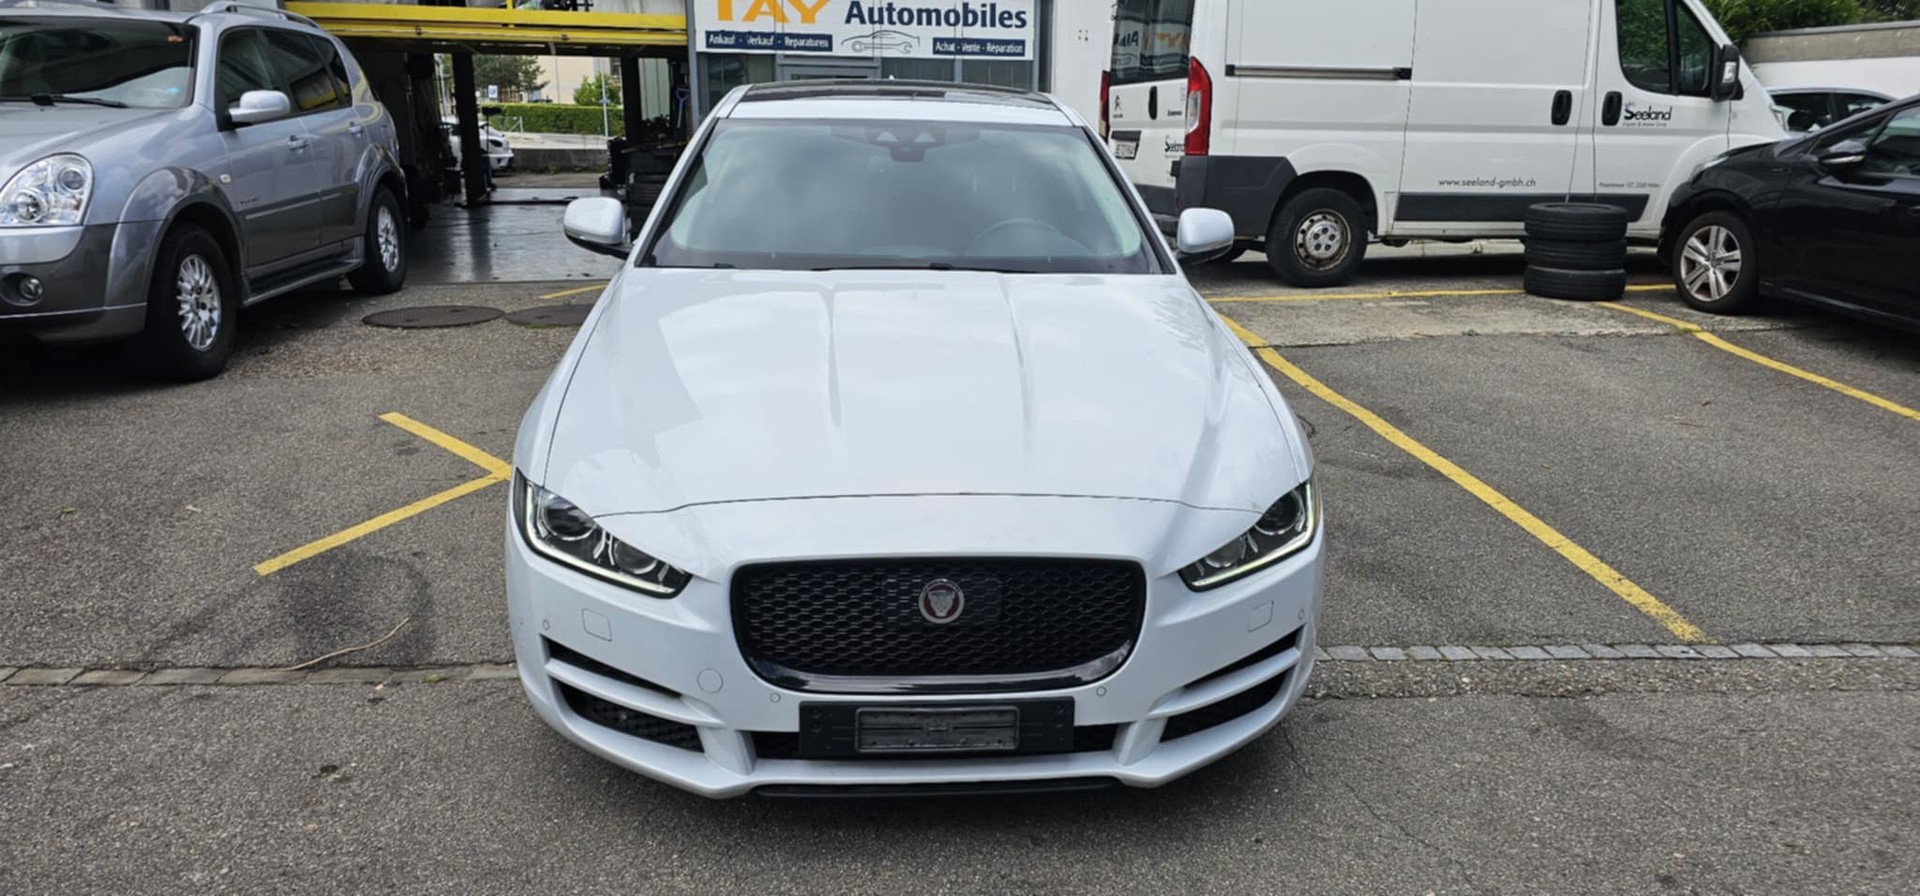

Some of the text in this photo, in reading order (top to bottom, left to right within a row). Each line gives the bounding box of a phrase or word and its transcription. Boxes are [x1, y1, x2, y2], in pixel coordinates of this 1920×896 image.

[844, 1, 1027, 28] Automobiles
[708, 34, 736, 44] Ankauf
[746, 35, 774, 46] Verkauf
[784, 36, 829, 48] Reparaturen
[935, 42, 955, 52] Achat
[961, 42, 981, 53] Vente
[1624, 105, 1673, 120] Seeland
[1438, 177, 1537, 189] www.seeland-gmbh.ch
